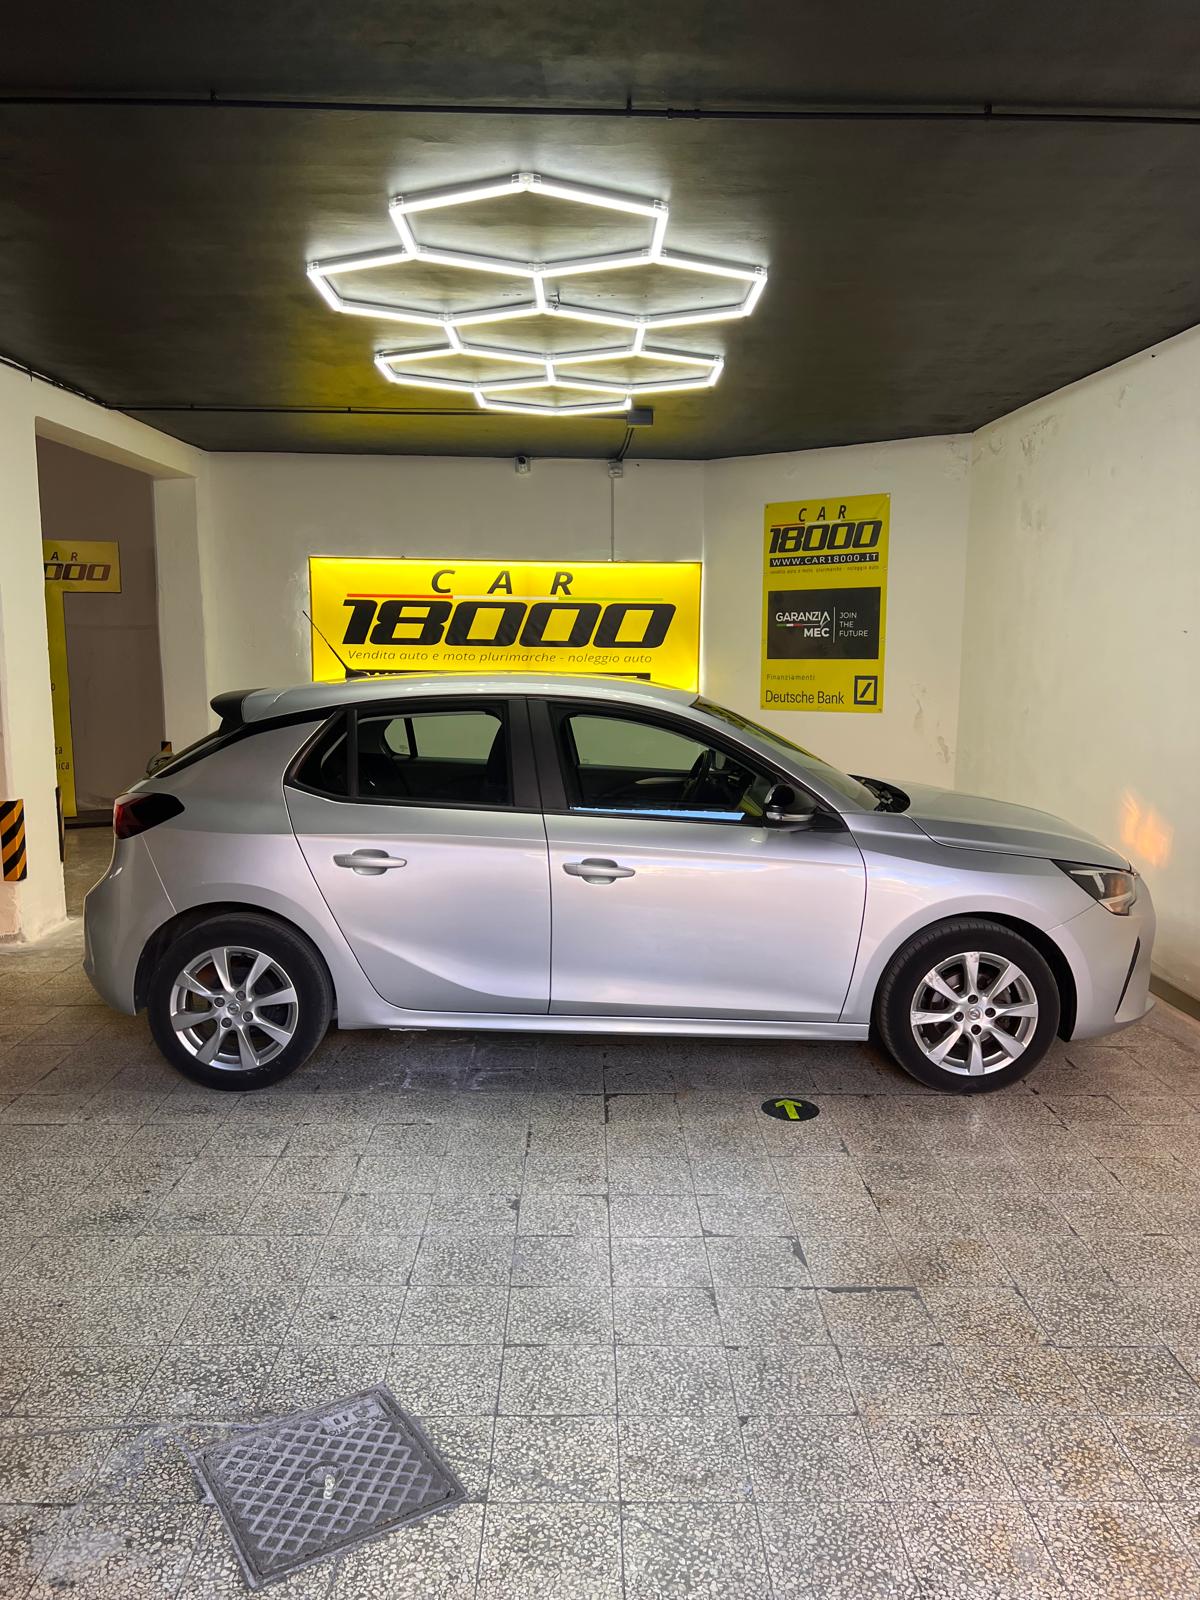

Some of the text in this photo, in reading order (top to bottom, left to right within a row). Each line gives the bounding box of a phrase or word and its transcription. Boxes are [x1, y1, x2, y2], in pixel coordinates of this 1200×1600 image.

[798, 505, 847, 522] CAR
[769, 520, 882, 554] 18000
[772, 553, 878, 566] WWW.CAR18000.IT
[431, 569, 574, 596] CAR
[775, 611, 831, 623] GARANZIA
[839, 611, 857, 619] JOIN
[342, 598, 676, 648] 18000
[839, 620, 854, 628] THE
[803, 627, 830, 638] MEC
[839, 629, 868, 637] FUTURE
[348, 650, 396, 661] Vendita
[399, 652, 428, 661] auto
[443, 652, 476, 661] moto
[478, 652, 556, 664] plurimarche
[568, 653, 620, 665] noleggio
[623, 655, 652, 663] auto
[766, 673, 816, 681] Finanziamenti
[765, 689, 845, 705] Deutsche Bank
